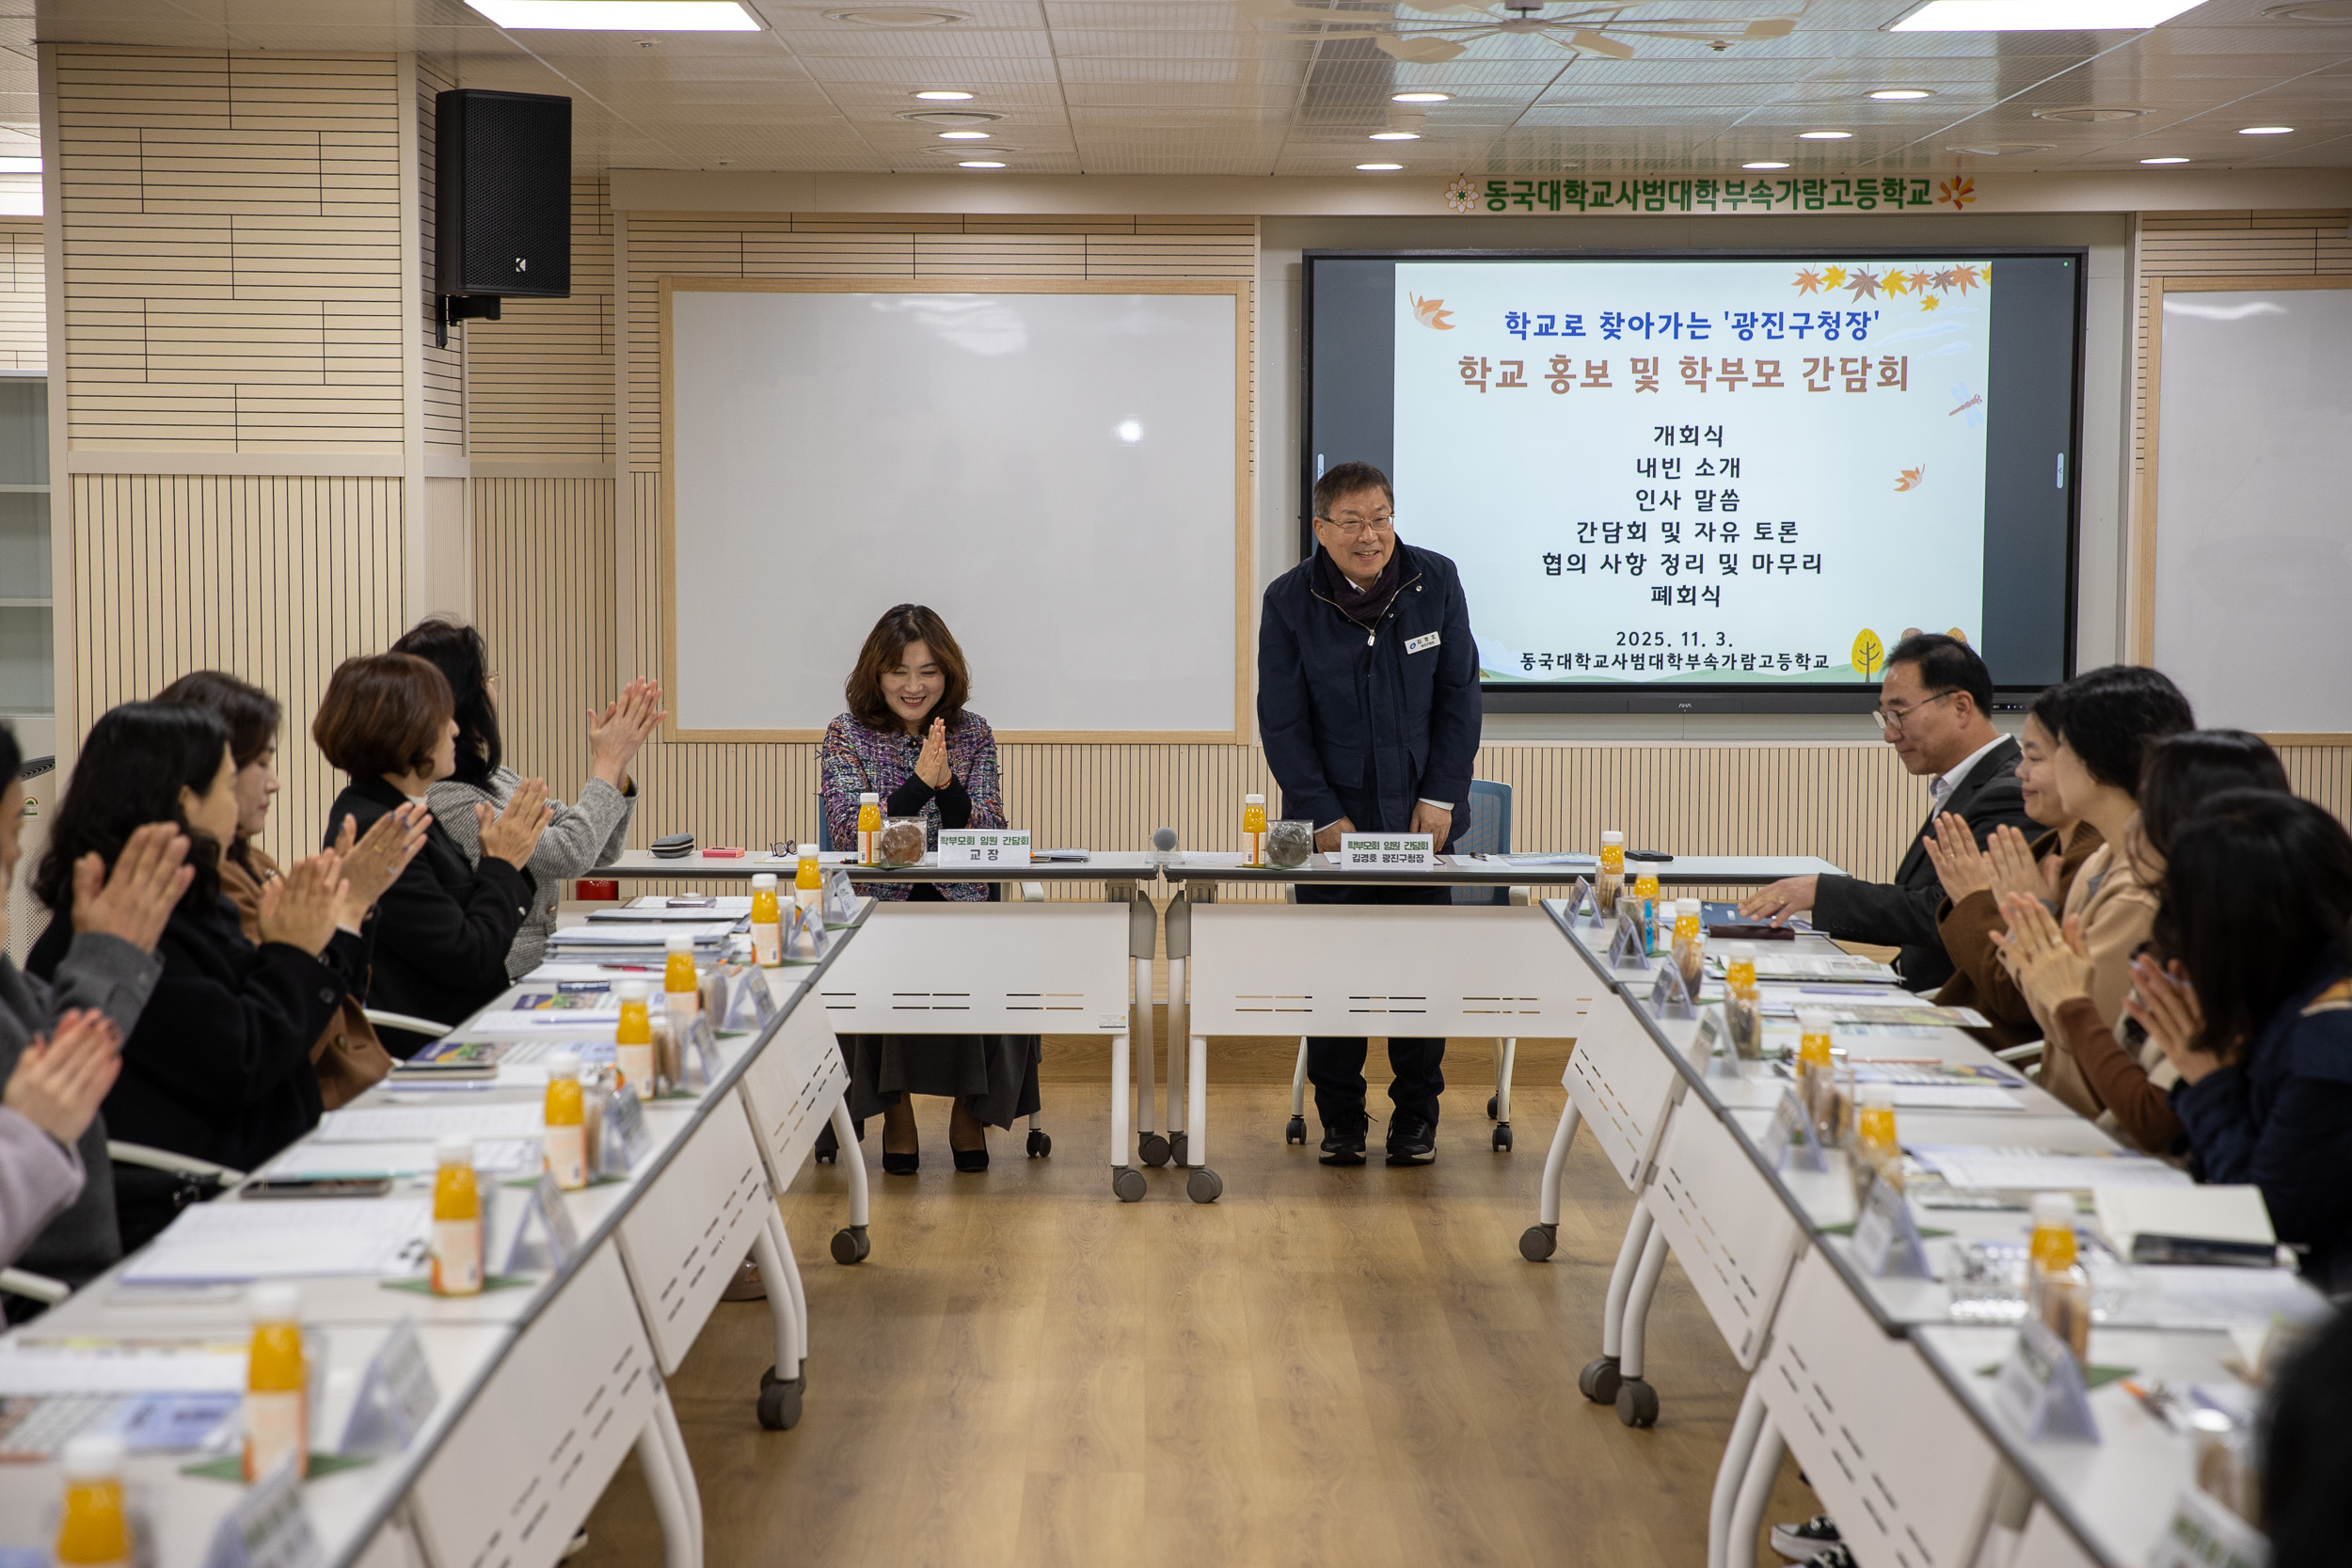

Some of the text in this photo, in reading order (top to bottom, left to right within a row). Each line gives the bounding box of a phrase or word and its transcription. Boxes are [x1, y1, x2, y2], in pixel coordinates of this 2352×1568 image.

[1484, 177, 1932, 213] 동국대학교사범대학부속가람고등학교
[1505, 310, 1880, 341] 학교로 찾아가는 '광진구청장'
[1458, 354, 1908, 394] 학교 홍보 및 학부모 간담회
[1654, 424, 1723, 448] 개회식
[1637, 457, 1740, 480] 내빈 소개
[1636, 489, 1740, 512] 인사 말씀
[1577, 521, 1798, 544] 간담회 및 자유 토론
[1542, 552, 1821, 576] 협의 사항 정리 및 마무리
[1651, 584, 1721, 608] 폐회식
[1616, 631, 1733, 647] 2025. 11. 3.
[1520, 652, 1830, 672] 동국대학교사범대학부속가람고등학교
[941, 836, 1029, 846] 학부모회 임원 간담회
[1347, 840, 1428, 850] 학부모회 임원 간담회
[1352, 853, 1424, 863] 김경호 광진구청장
